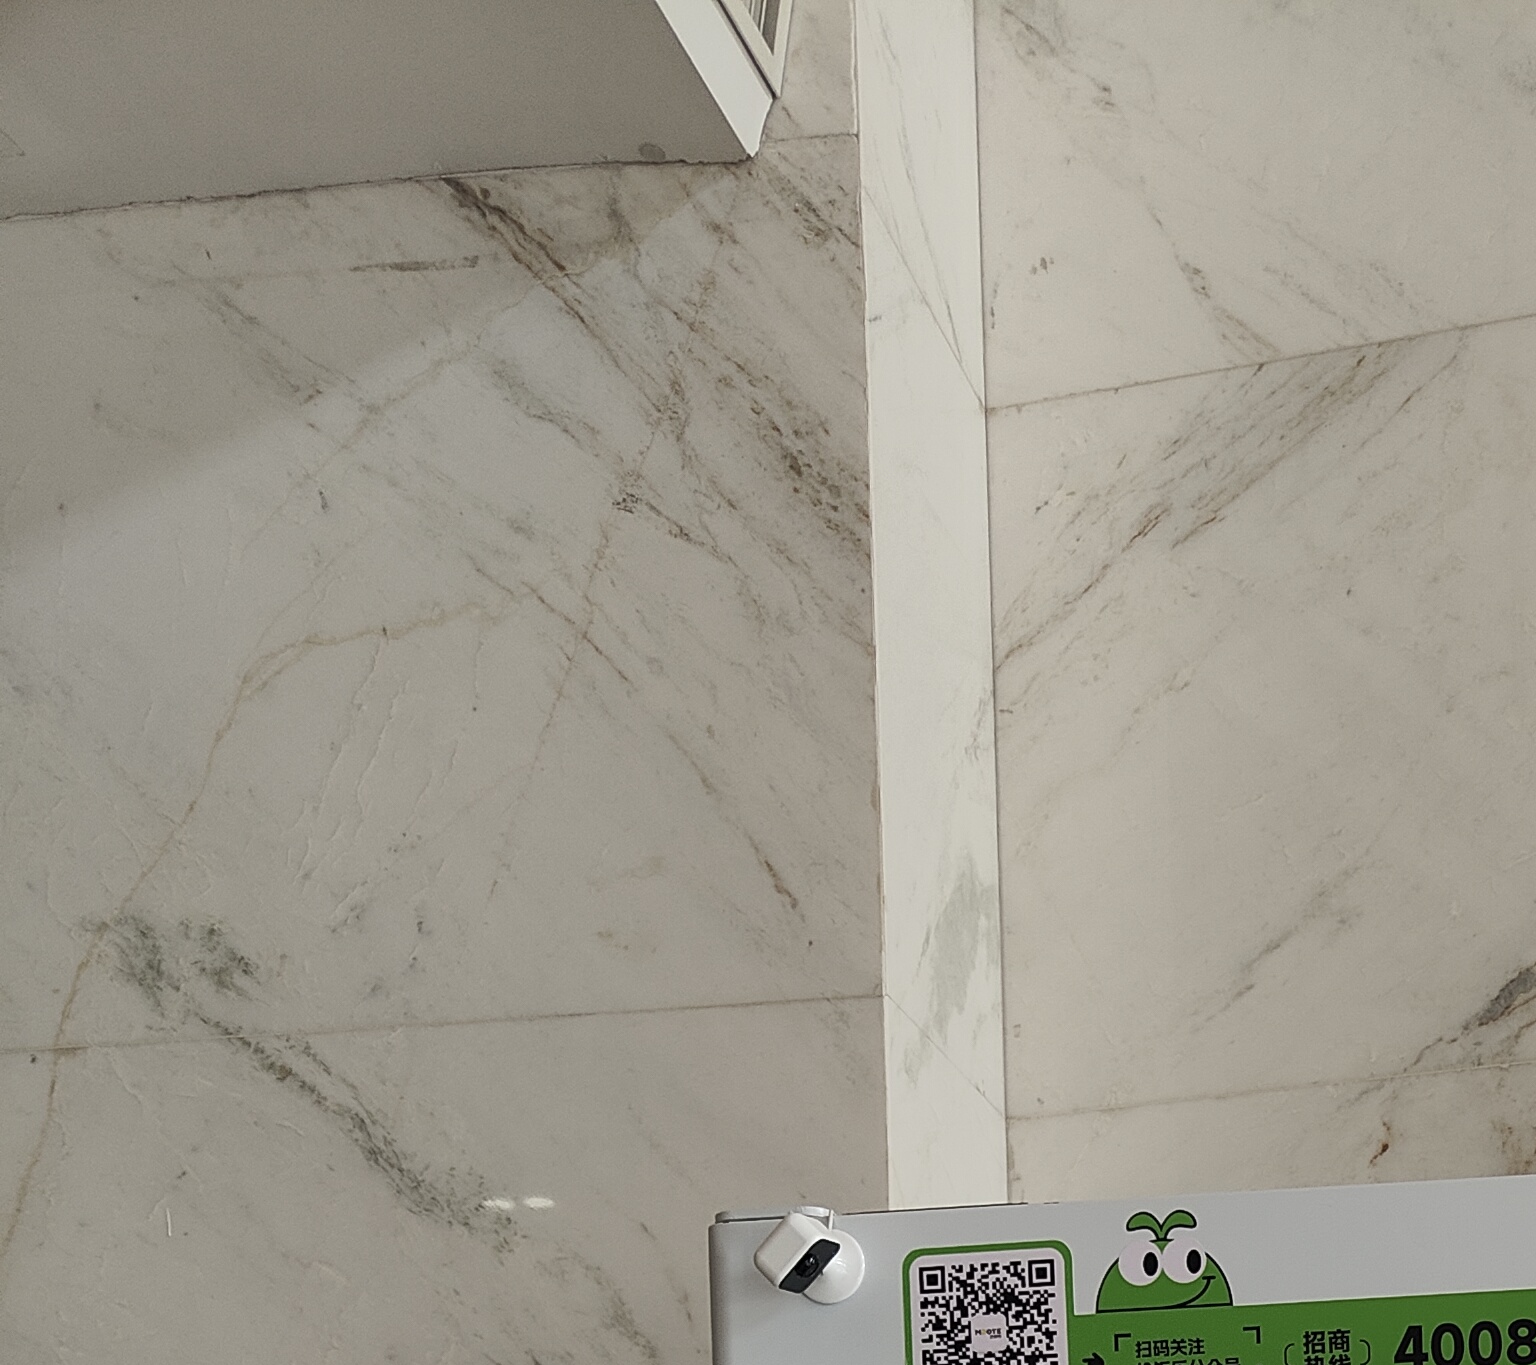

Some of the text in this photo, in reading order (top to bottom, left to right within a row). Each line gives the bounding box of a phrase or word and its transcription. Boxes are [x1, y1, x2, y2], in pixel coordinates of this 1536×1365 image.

[1135, 1338, 1205, 1358] 扫码关注
[1303, 1329, 1351, 1354] 招商
